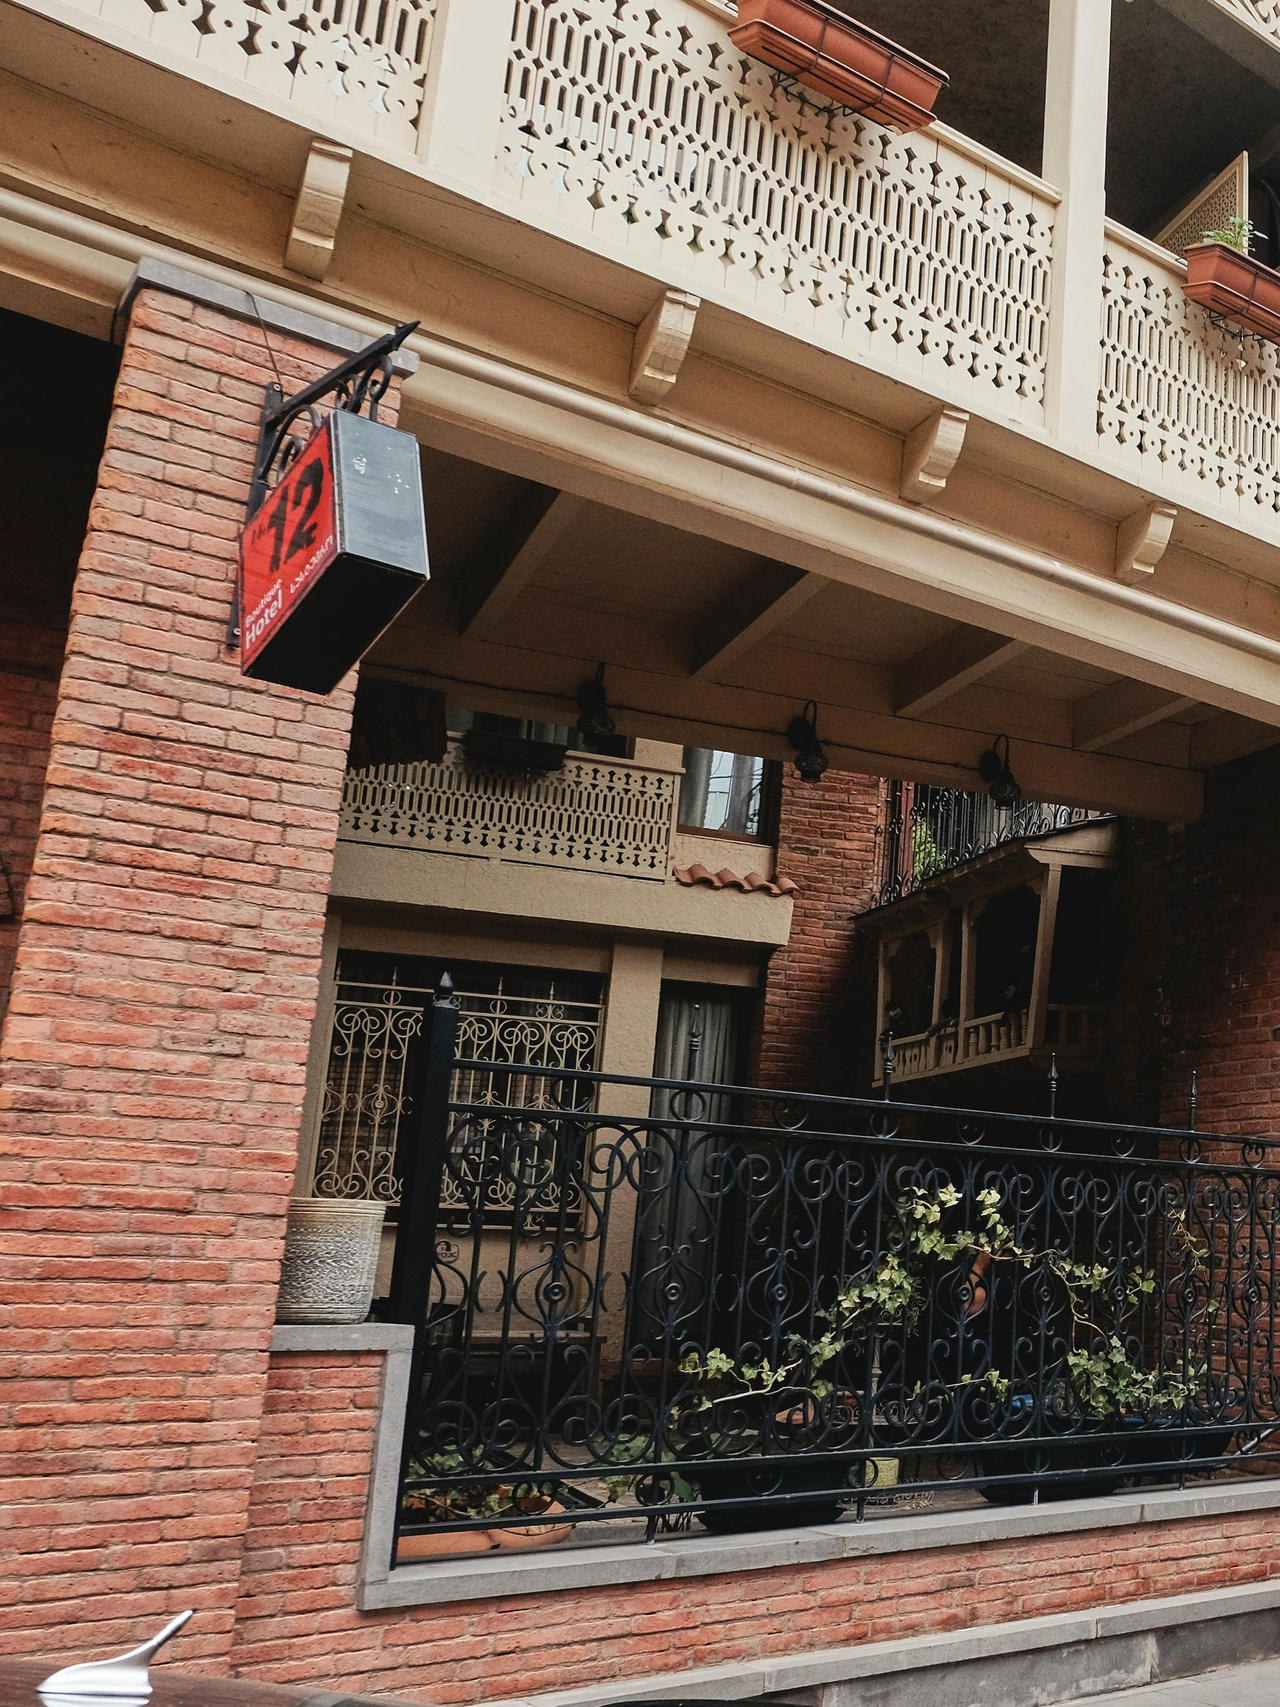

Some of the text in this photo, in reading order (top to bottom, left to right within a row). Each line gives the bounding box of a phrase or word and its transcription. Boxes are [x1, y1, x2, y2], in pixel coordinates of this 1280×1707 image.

[267, 457, 324, 574] 12
[245, 579, 282, 628] Boutique
[245, 588, 283, 649] Hotel
